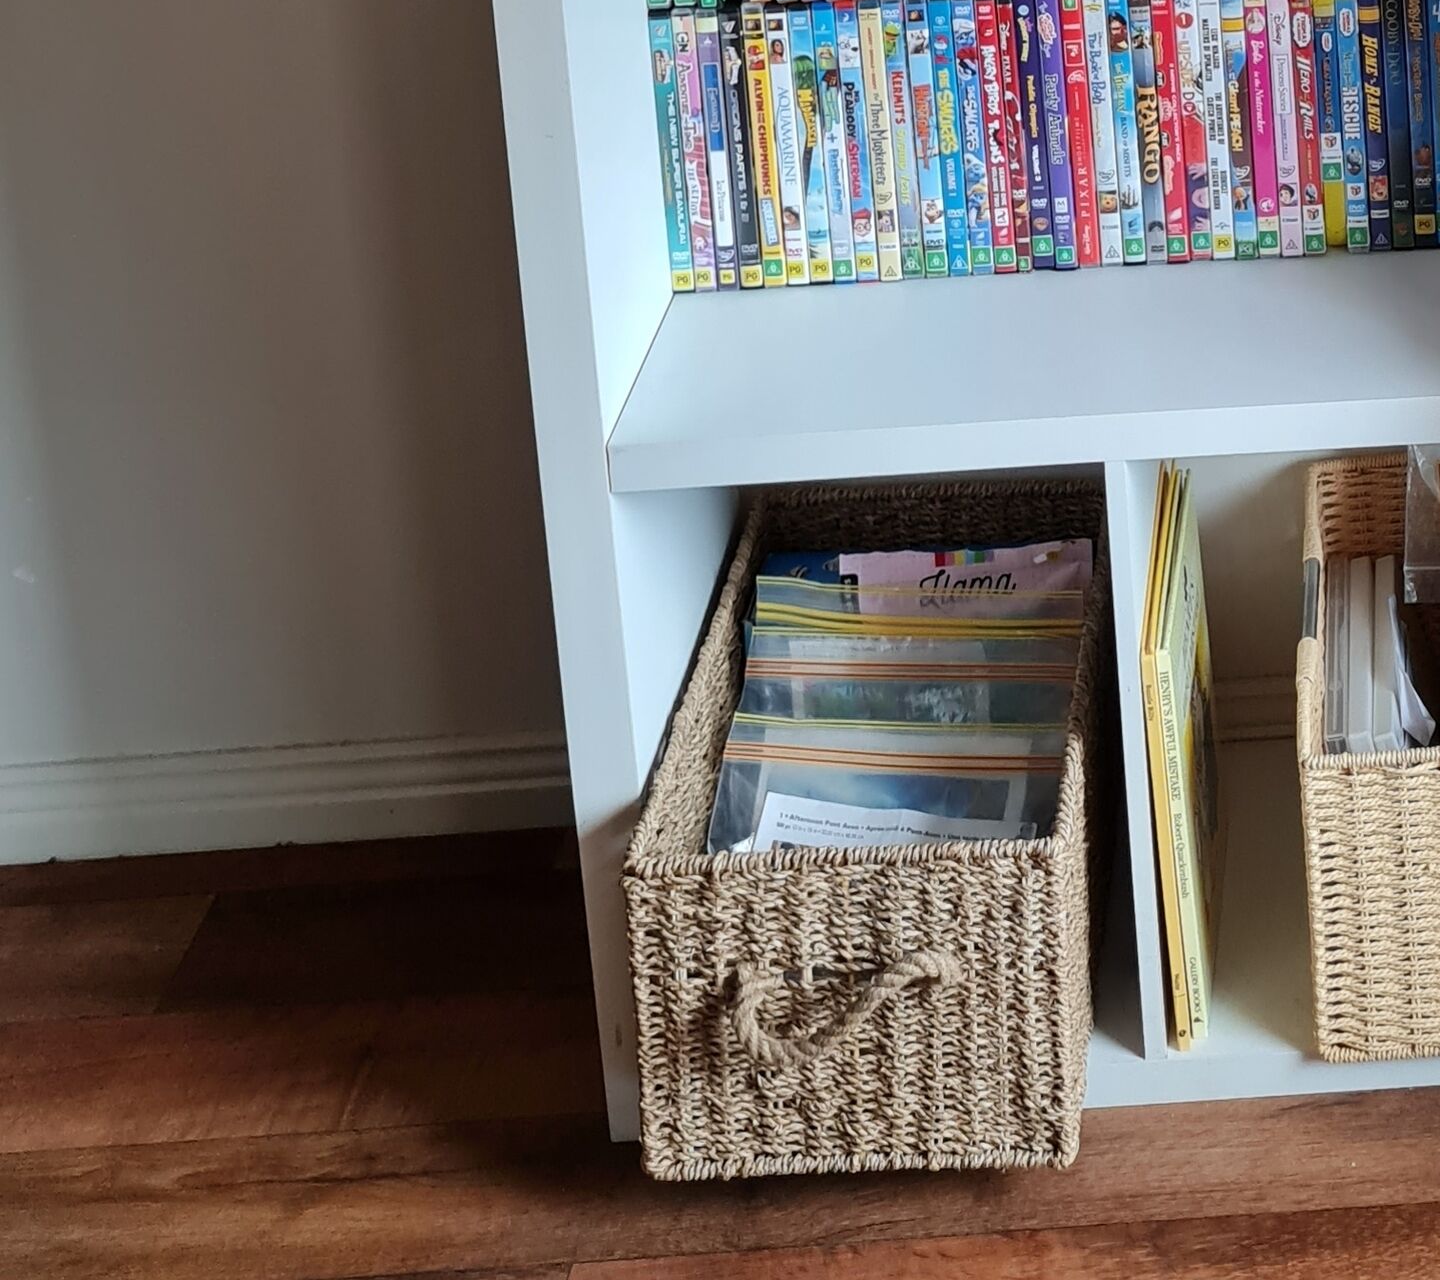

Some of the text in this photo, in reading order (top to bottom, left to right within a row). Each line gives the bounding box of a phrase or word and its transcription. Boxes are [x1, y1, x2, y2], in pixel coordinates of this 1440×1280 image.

[842, 81, 857, 137] PEABODY
[891, 71, 906, 125] KERMIT'S
[1361, 33, 1382, 134] HOME RANGE
[777, 86, 797, 186] AQUAMARINE
[1048, 114, 1066, 165] Animals
[1136, 86, 1161, 184] RANGO
[1229, 113, 1244, 151] PEACH
[1342, 87, 1361, 140] RESCUE
[758, 125, 772, 196] CHIPMUNKS
[1077, 167, 1090, 218] PIXAR
[1159, 671, 1191, 900] HENRY'S AWFUL MISTAKE Robert Quackenbush
[1188, 956, 1202, 1013] GALLERY BOOKS
